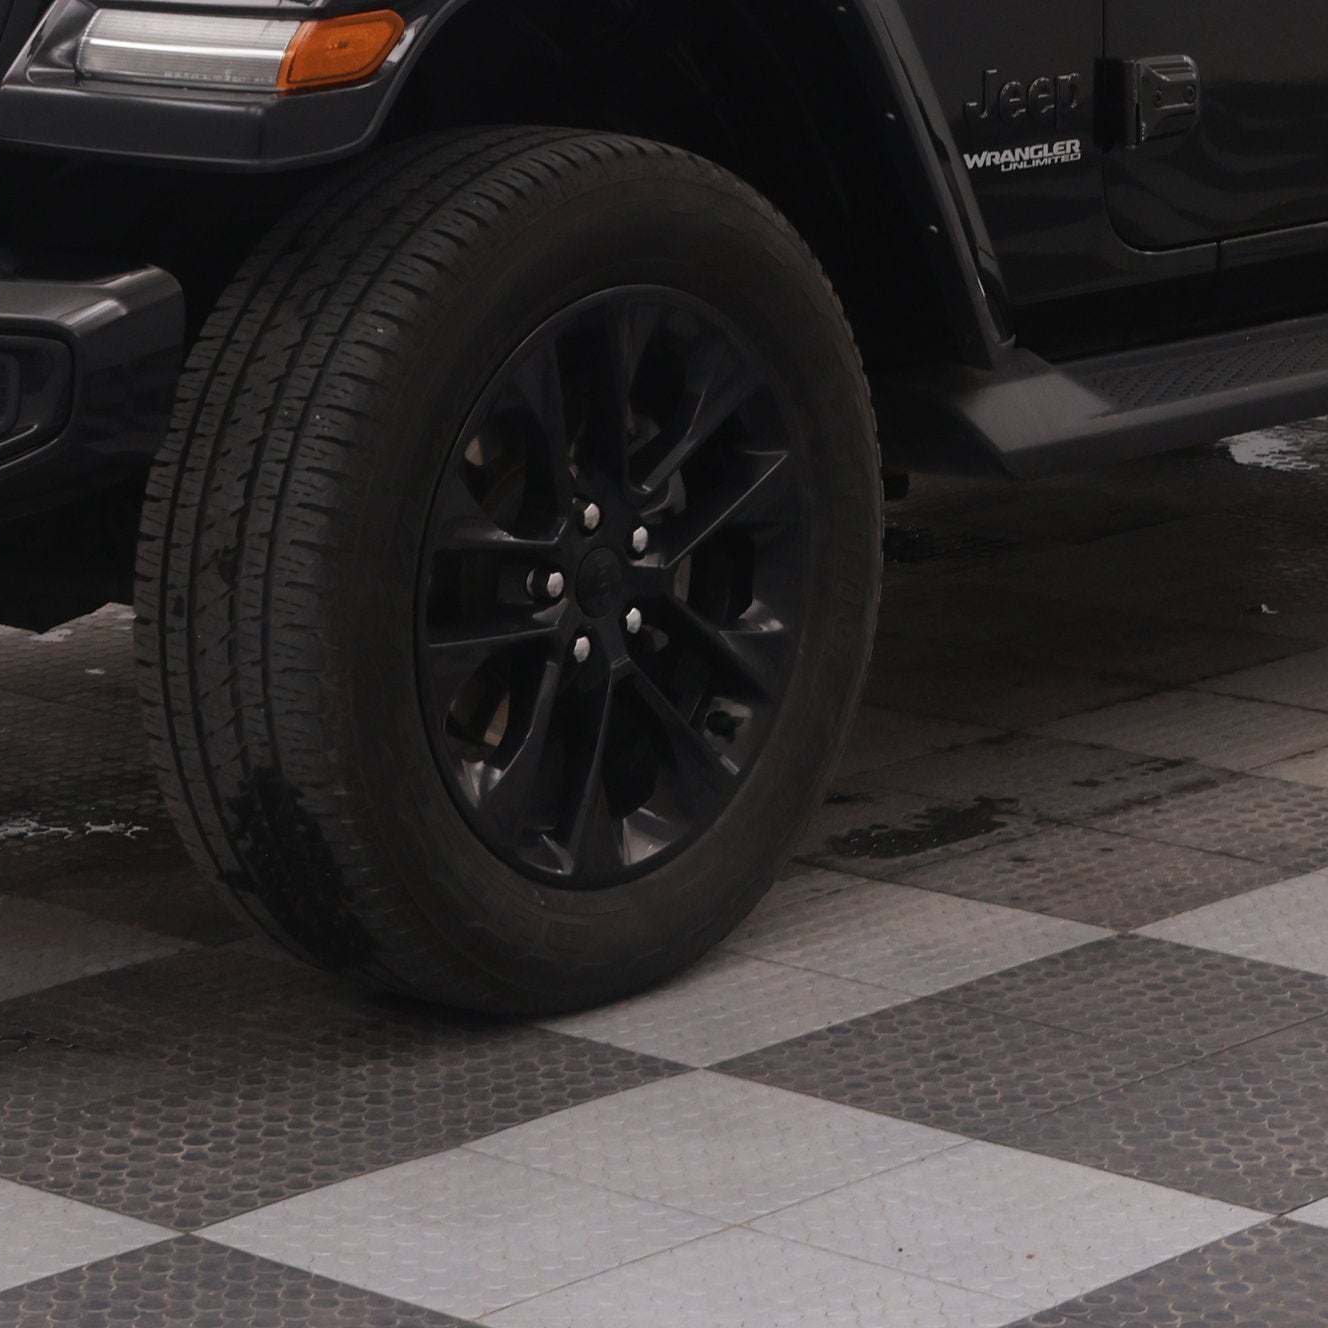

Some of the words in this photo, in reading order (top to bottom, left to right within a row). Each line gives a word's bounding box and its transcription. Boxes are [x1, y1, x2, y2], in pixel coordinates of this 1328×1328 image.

[962, 68, 1083, 131] Jeep
[963, 138, 1081, 170] WRANGLER
[1001, 152, 1082, 172] UNLIMITED
